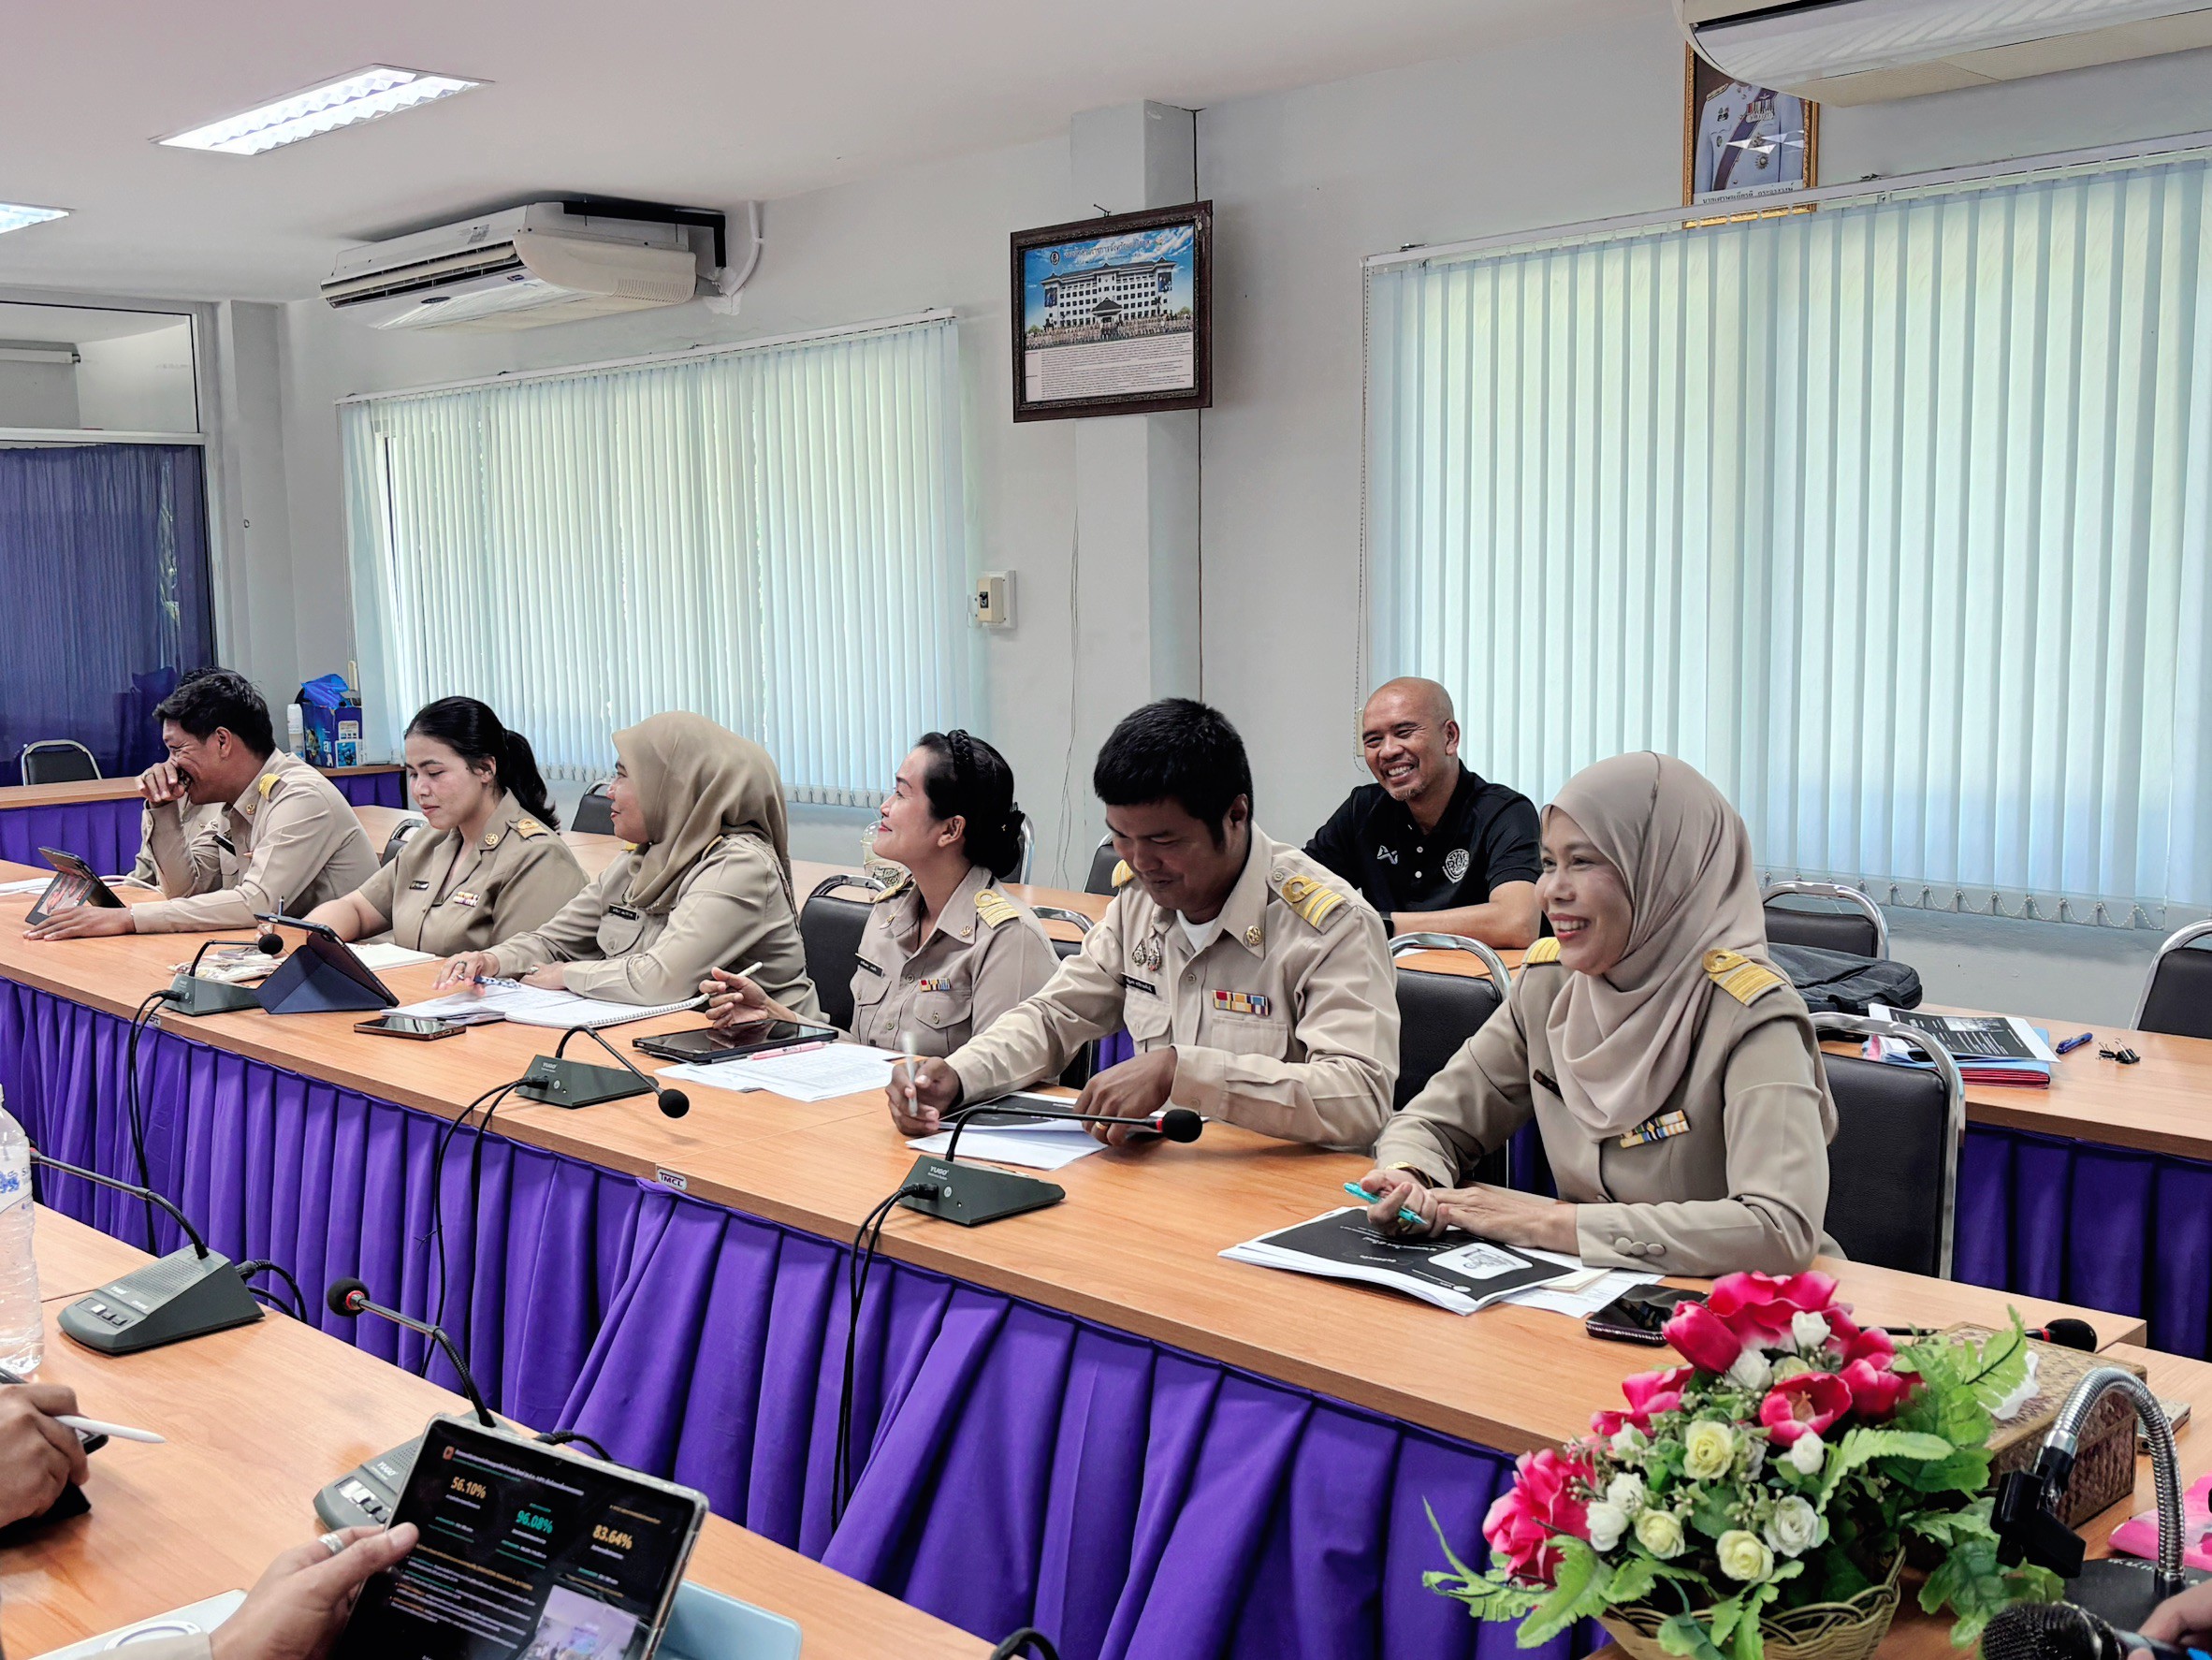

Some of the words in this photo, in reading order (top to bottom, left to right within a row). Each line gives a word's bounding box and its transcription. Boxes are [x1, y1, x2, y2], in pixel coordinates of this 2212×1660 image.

[930, 1166, 947, 1175] YUGO
[450, 1476, 487, 1499] 56.10%
[516, 1509, 553, 1535] 96.08%
[592, 1524, 633, 1550] 83.64%
